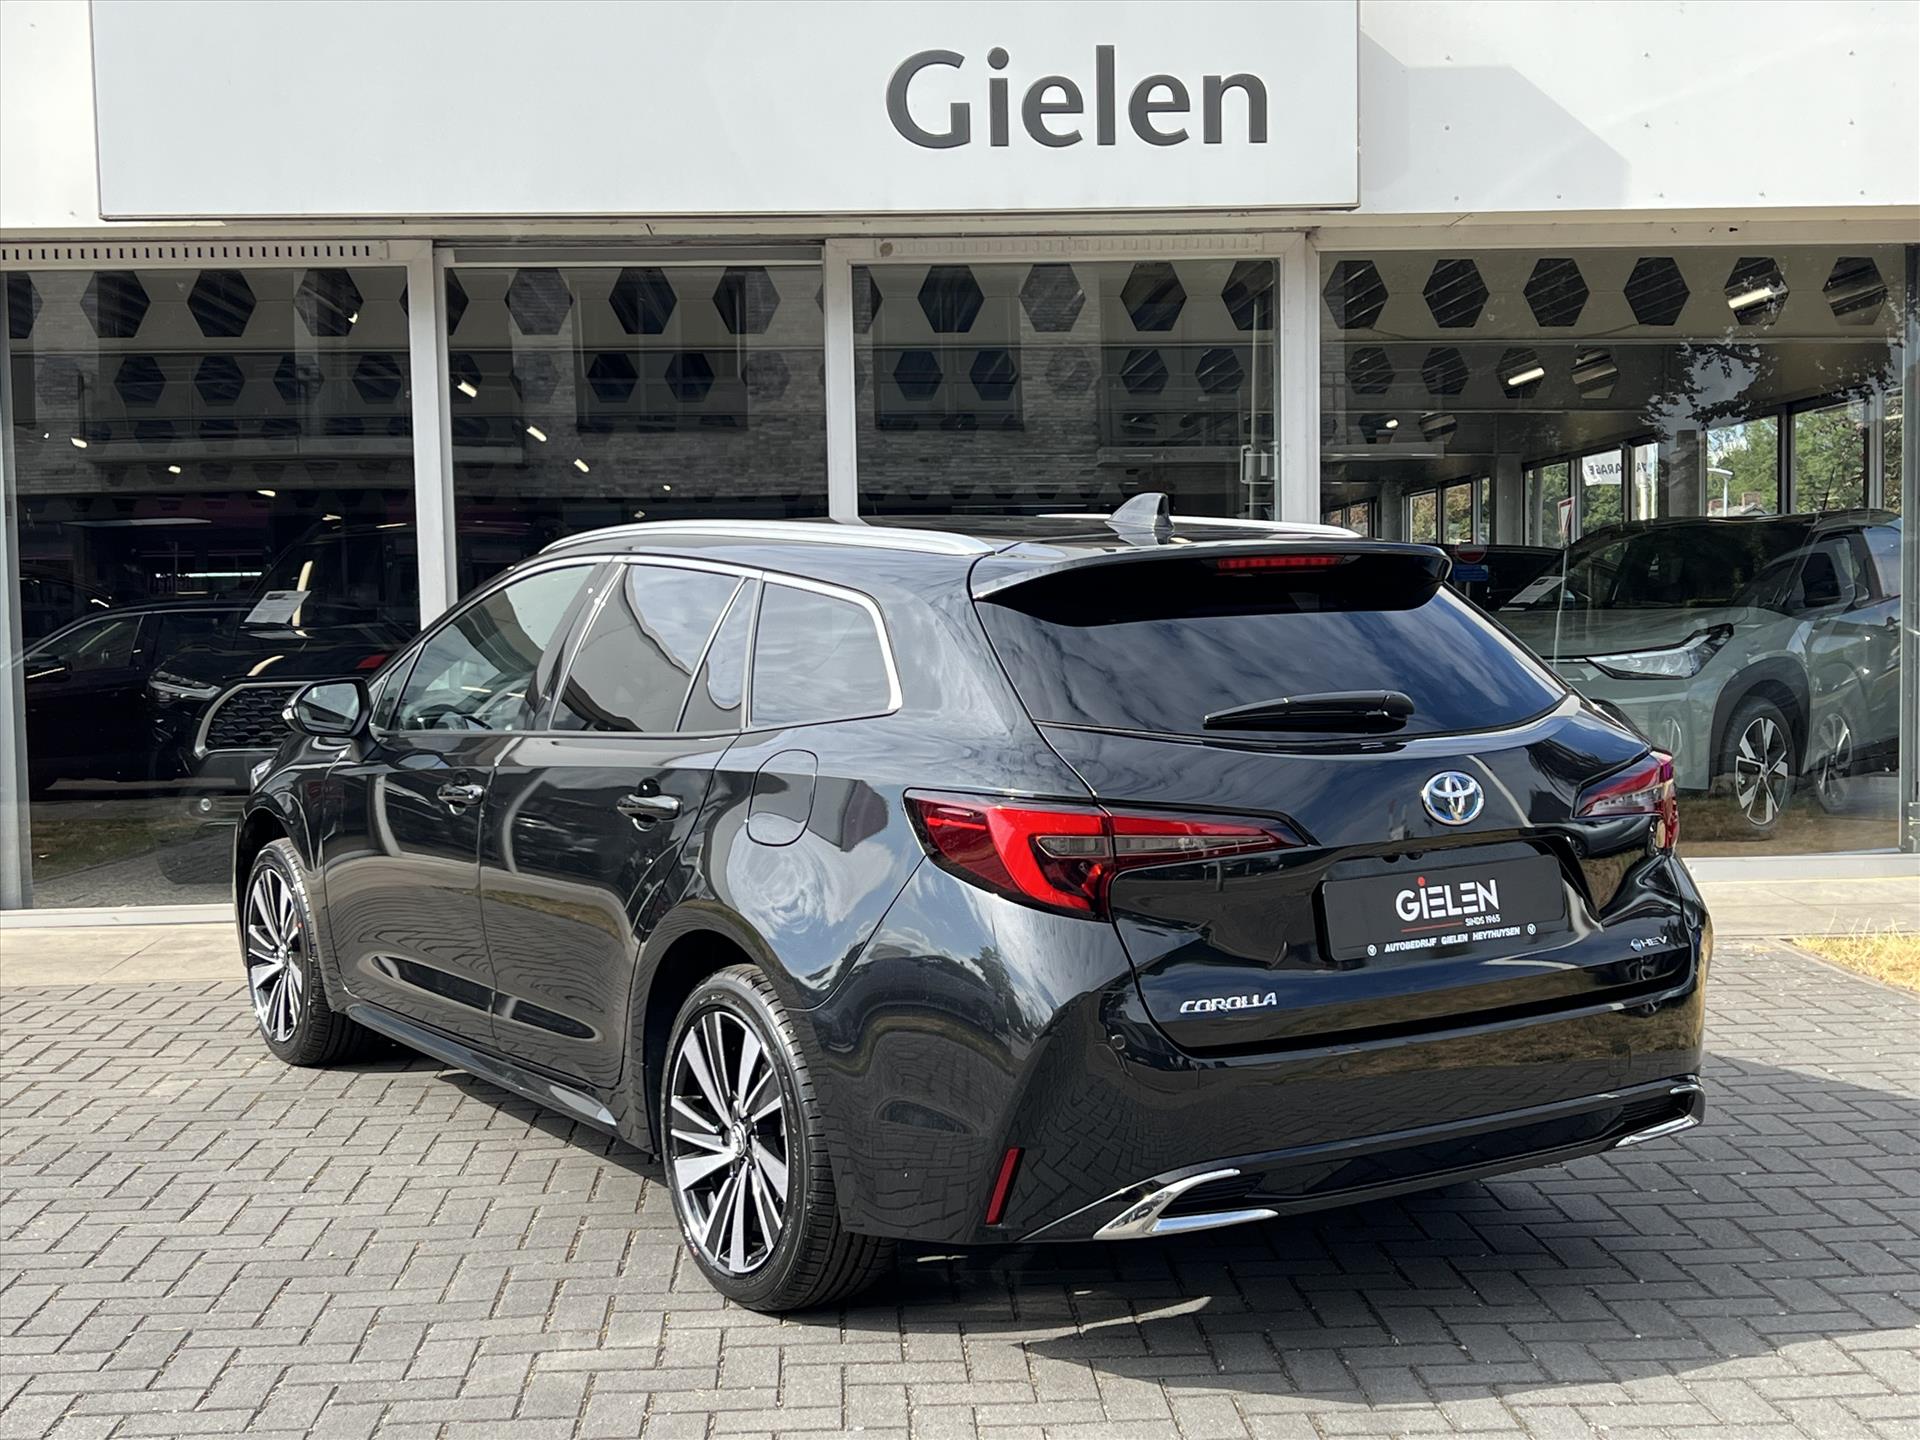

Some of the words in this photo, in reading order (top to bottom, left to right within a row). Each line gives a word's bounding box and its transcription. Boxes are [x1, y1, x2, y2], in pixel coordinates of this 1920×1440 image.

[886, 44, 1268, 149] Gielen
[1465, 917, 1485, 927] SINDS
[1384, 937, 1437, 953] AUTOBEDRIJF
[1441, 933, 1468, 945] GIELEN
[1472, 927, 1521, 941] HEYTHUYSEN
[1639, 936, 1667, 948] HEV
[1180, 992, 1277, 1013] COROLLA
